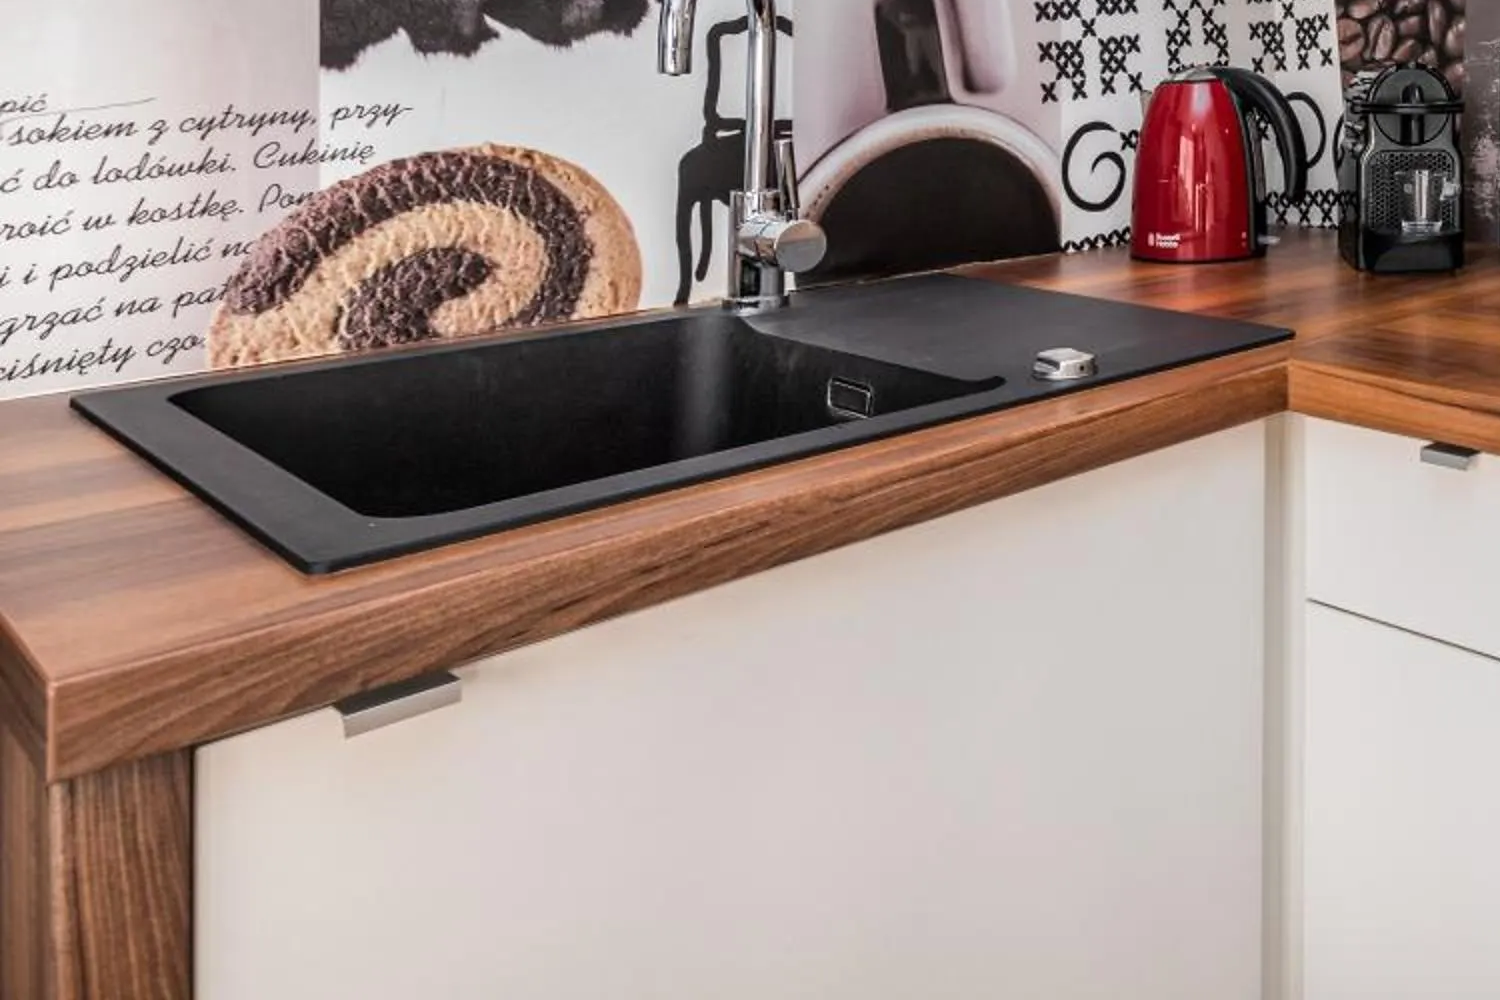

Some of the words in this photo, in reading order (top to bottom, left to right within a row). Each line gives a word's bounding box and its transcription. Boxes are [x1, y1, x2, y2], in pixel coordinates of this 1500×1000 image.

[8, 113, 138, 147] sokiem
[147, 119, 170, 146] z
[178, 103, 317, 141] cytryny,
[329, 102, 414, 131] przy-
[32, 159, 80, 191] do
[91, 146, 237, 186] lodówki.
[252, 137, 376, 170] Cukinię
[82, 214, 117, 231] w
[126, 189, 246, 227] kostkę.
[23, 263, 39, 285] i
[48, 235, 215, 293] podzielić
[115, 297, 164, 318] na
